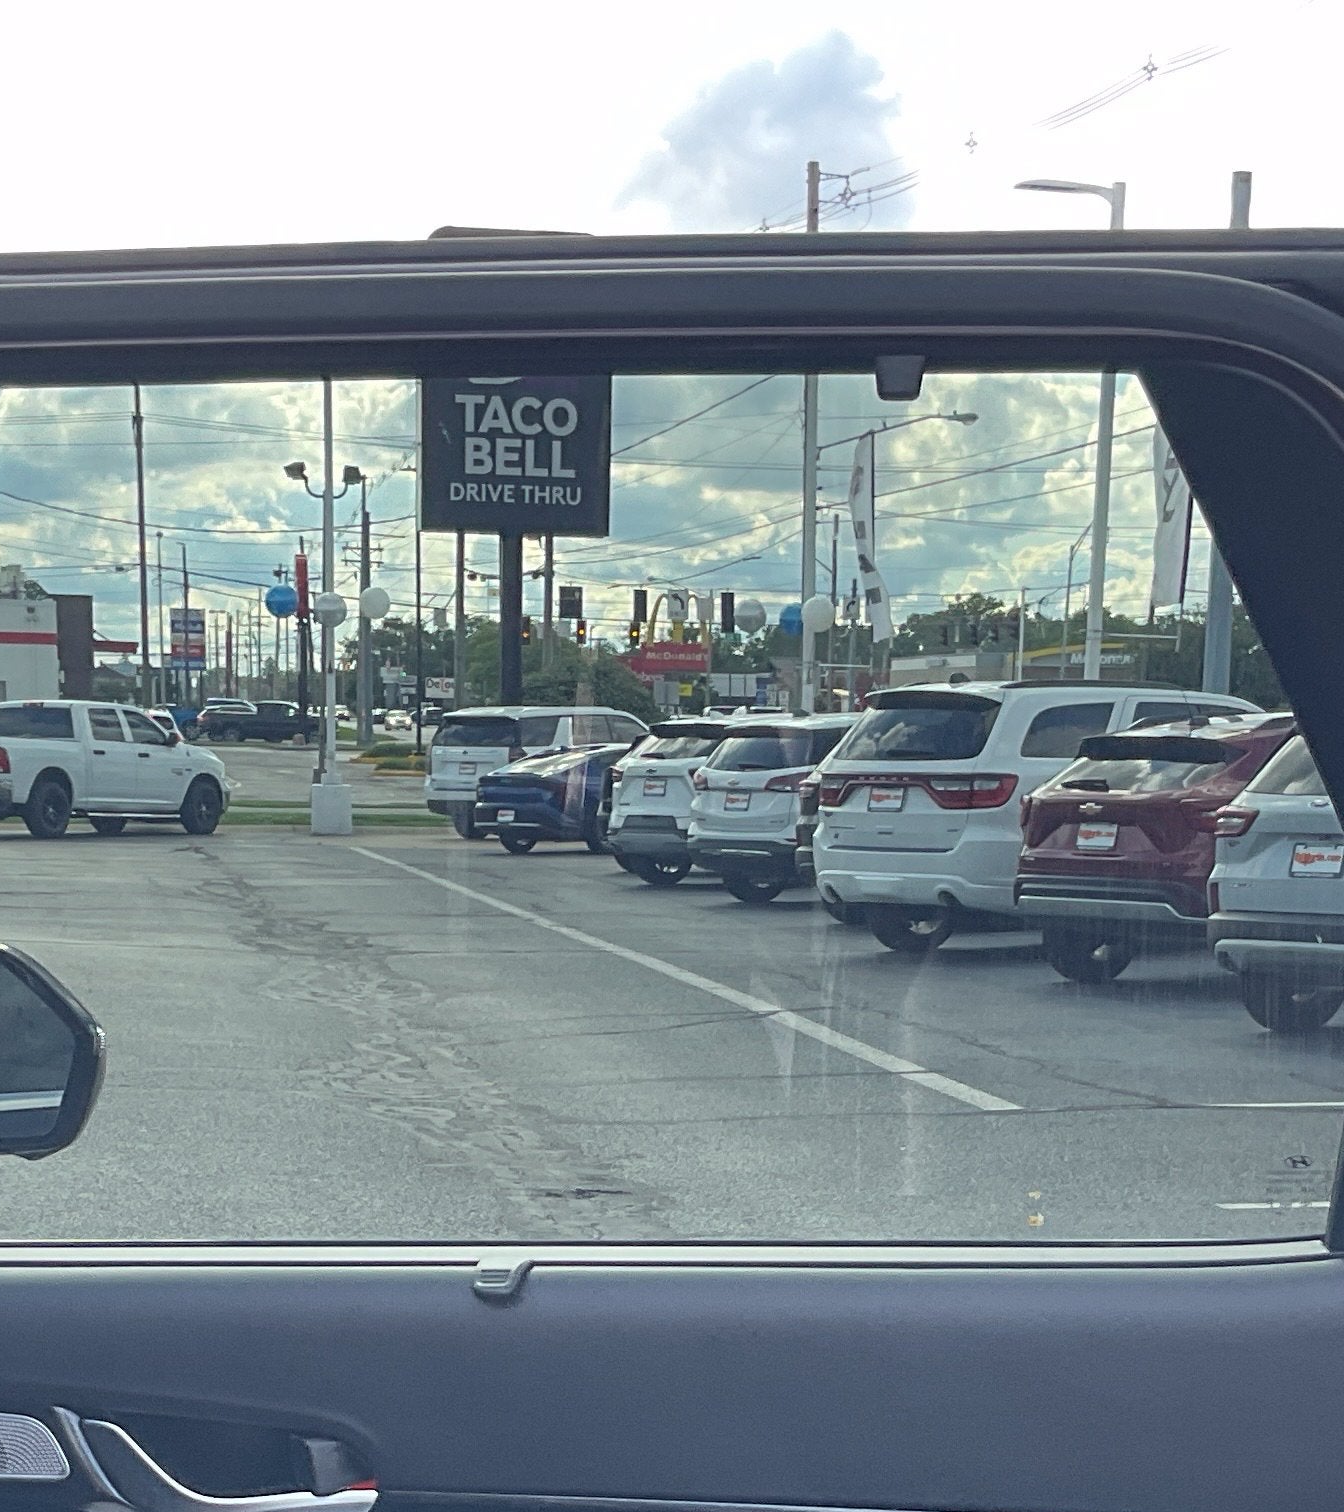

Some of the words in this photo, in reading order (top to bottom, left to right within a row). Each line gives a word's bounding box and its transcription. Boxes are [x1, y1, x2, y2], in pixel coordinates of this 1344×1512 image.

[454, 393, 578, 437] TACO
[464, 436, 576, 479] BELL
[449, 482, 515, 503] DRIVE
[521, 485, 582, 506] THRU
